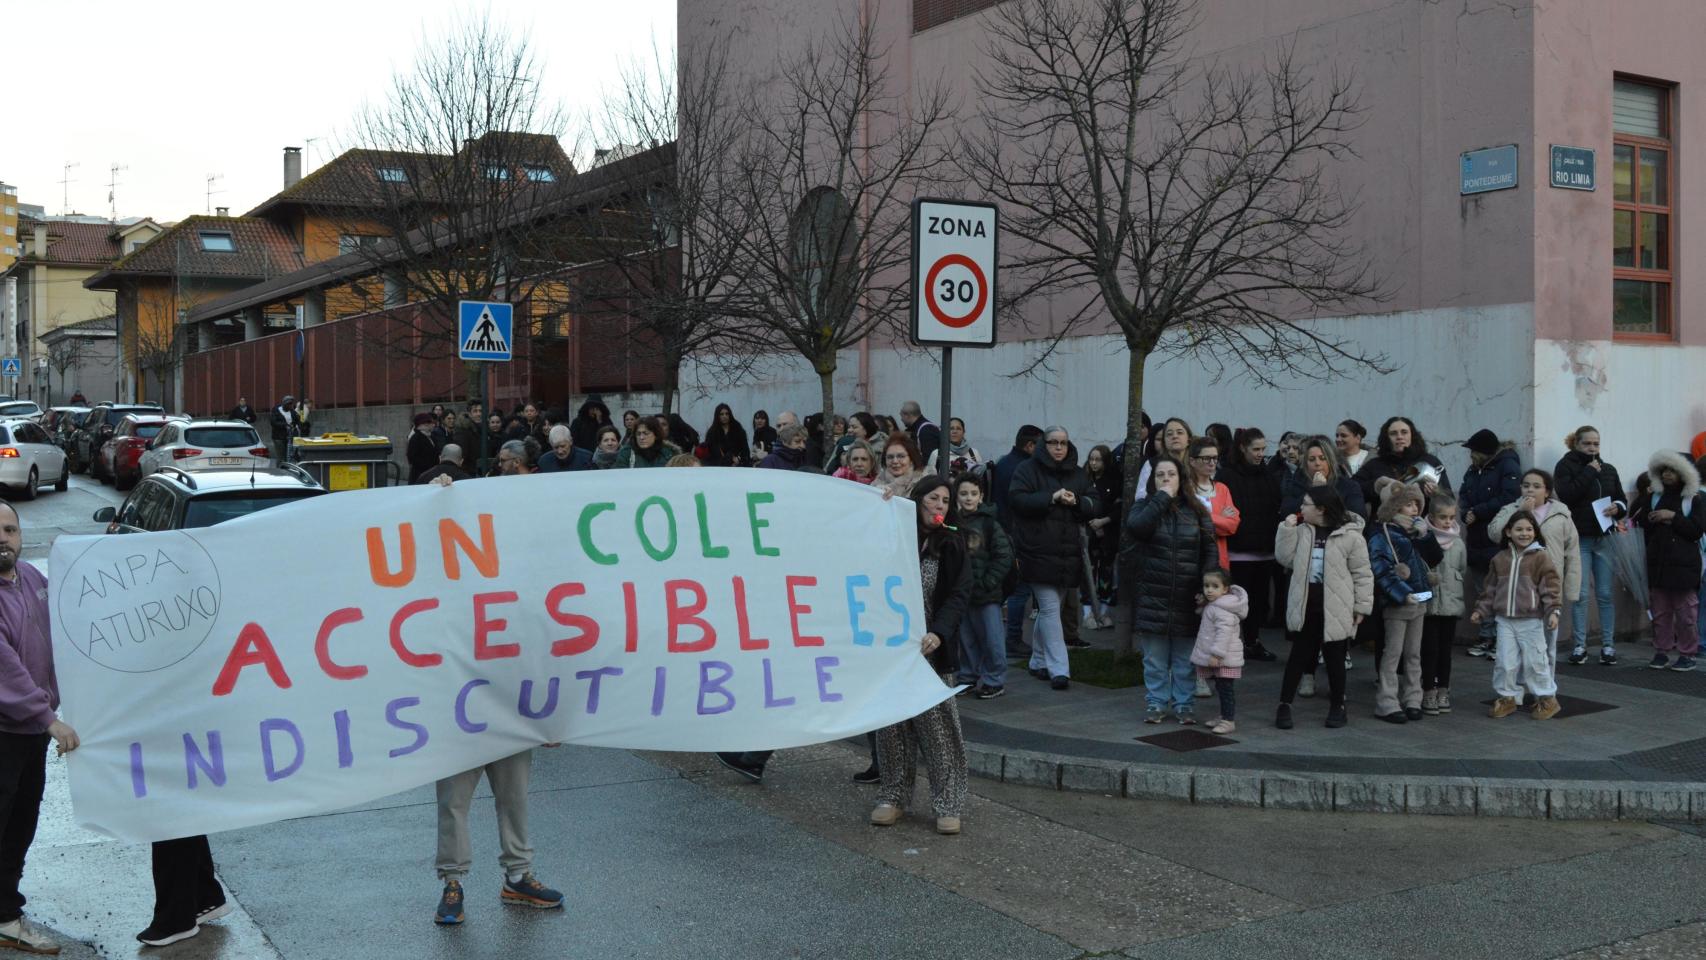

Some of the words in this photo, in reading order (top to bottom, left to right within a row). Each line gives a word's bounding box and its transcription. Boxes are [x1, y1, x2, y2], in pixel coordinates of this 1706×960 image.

[1464, 173, 1513, 189] PONTEDEUME
[1556, 171, 1569, 184] RIO
[1570, 173, 1591, 185] LIMIA
[928, 216, 987, 238] ZONA
[940, 278, 974, 303] 30
[366, 513, 500, 587] UN
[577, 491, 781, 566] COLE
[88, 584, 218, 657] ATURUXO
[211, 575, 825, 697] ACCESIBLE
[845, 574, 911, 647] ES
[129, 656, 844, 799] INDISCUTIBLE
